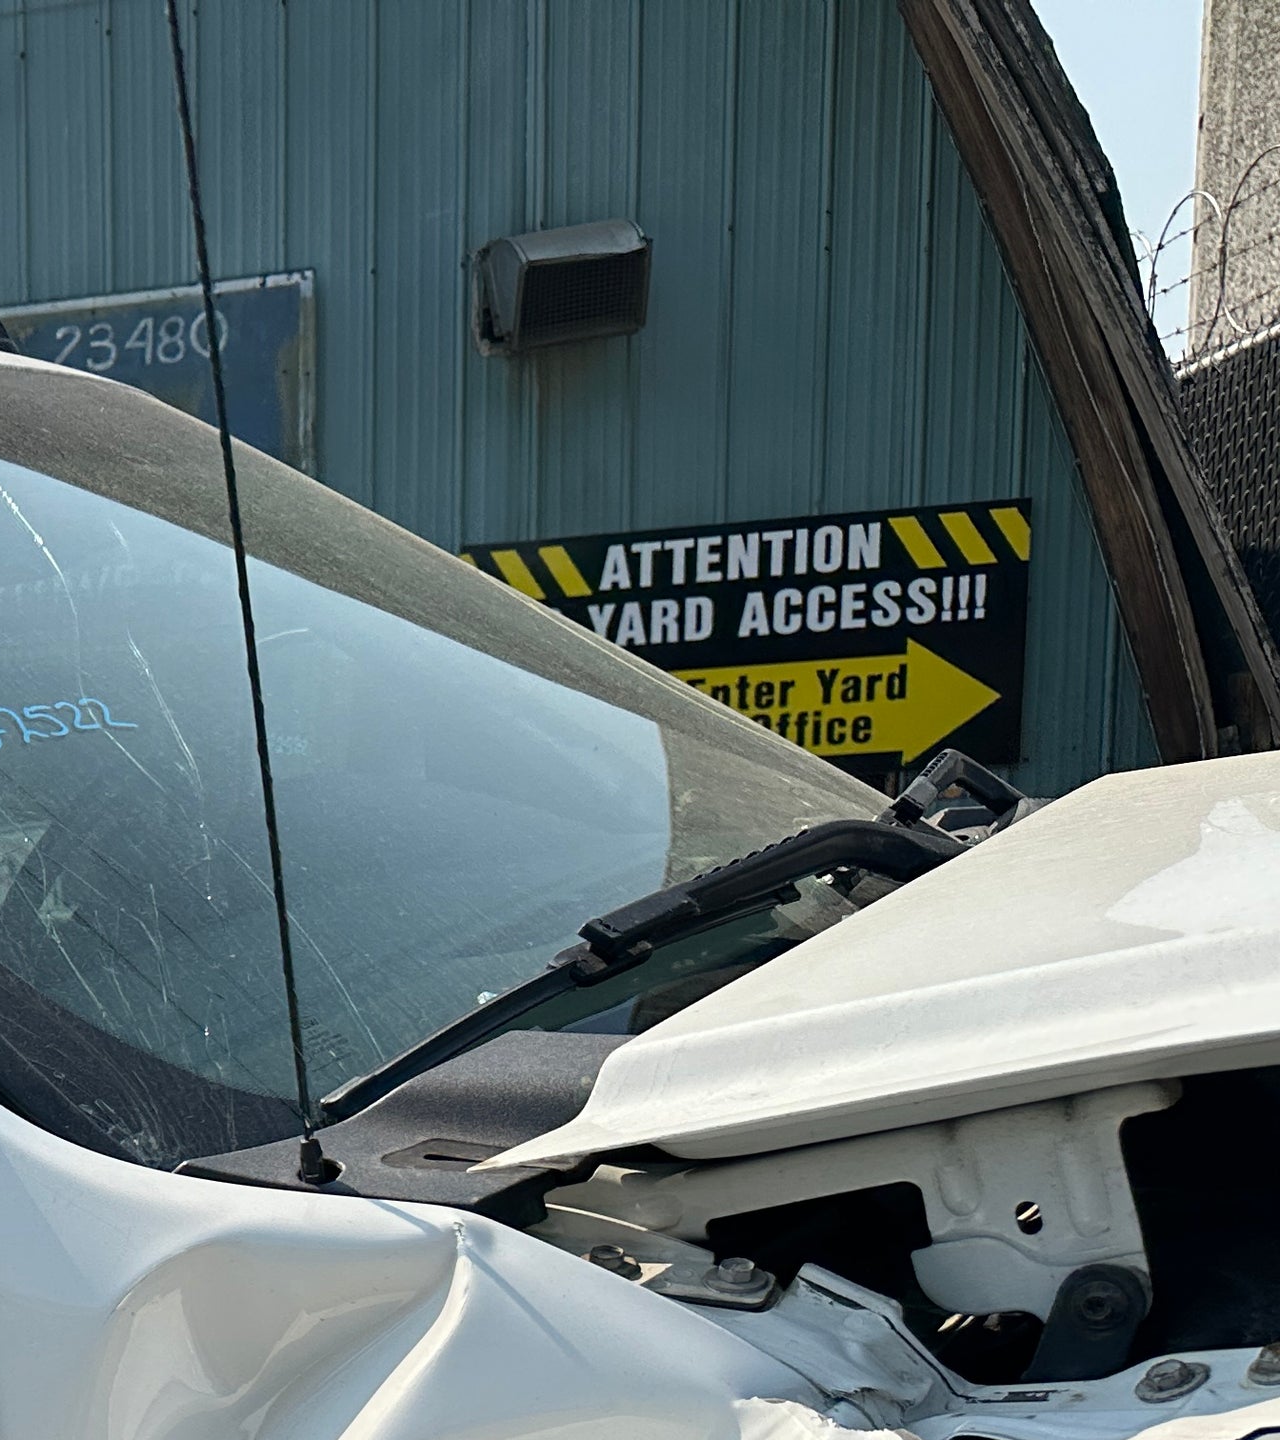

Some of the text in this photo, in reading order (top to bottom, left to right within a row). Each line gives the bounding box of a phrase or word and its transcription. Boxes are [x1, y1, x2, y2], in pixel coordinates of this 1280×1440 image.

[54, 309, 228, 371] 23480
[598, 521, 881, 593] ATTENTION
[587, 573, 987, 648] YARD ACCESS!!!
[816, 663, 908, 706] Yard
